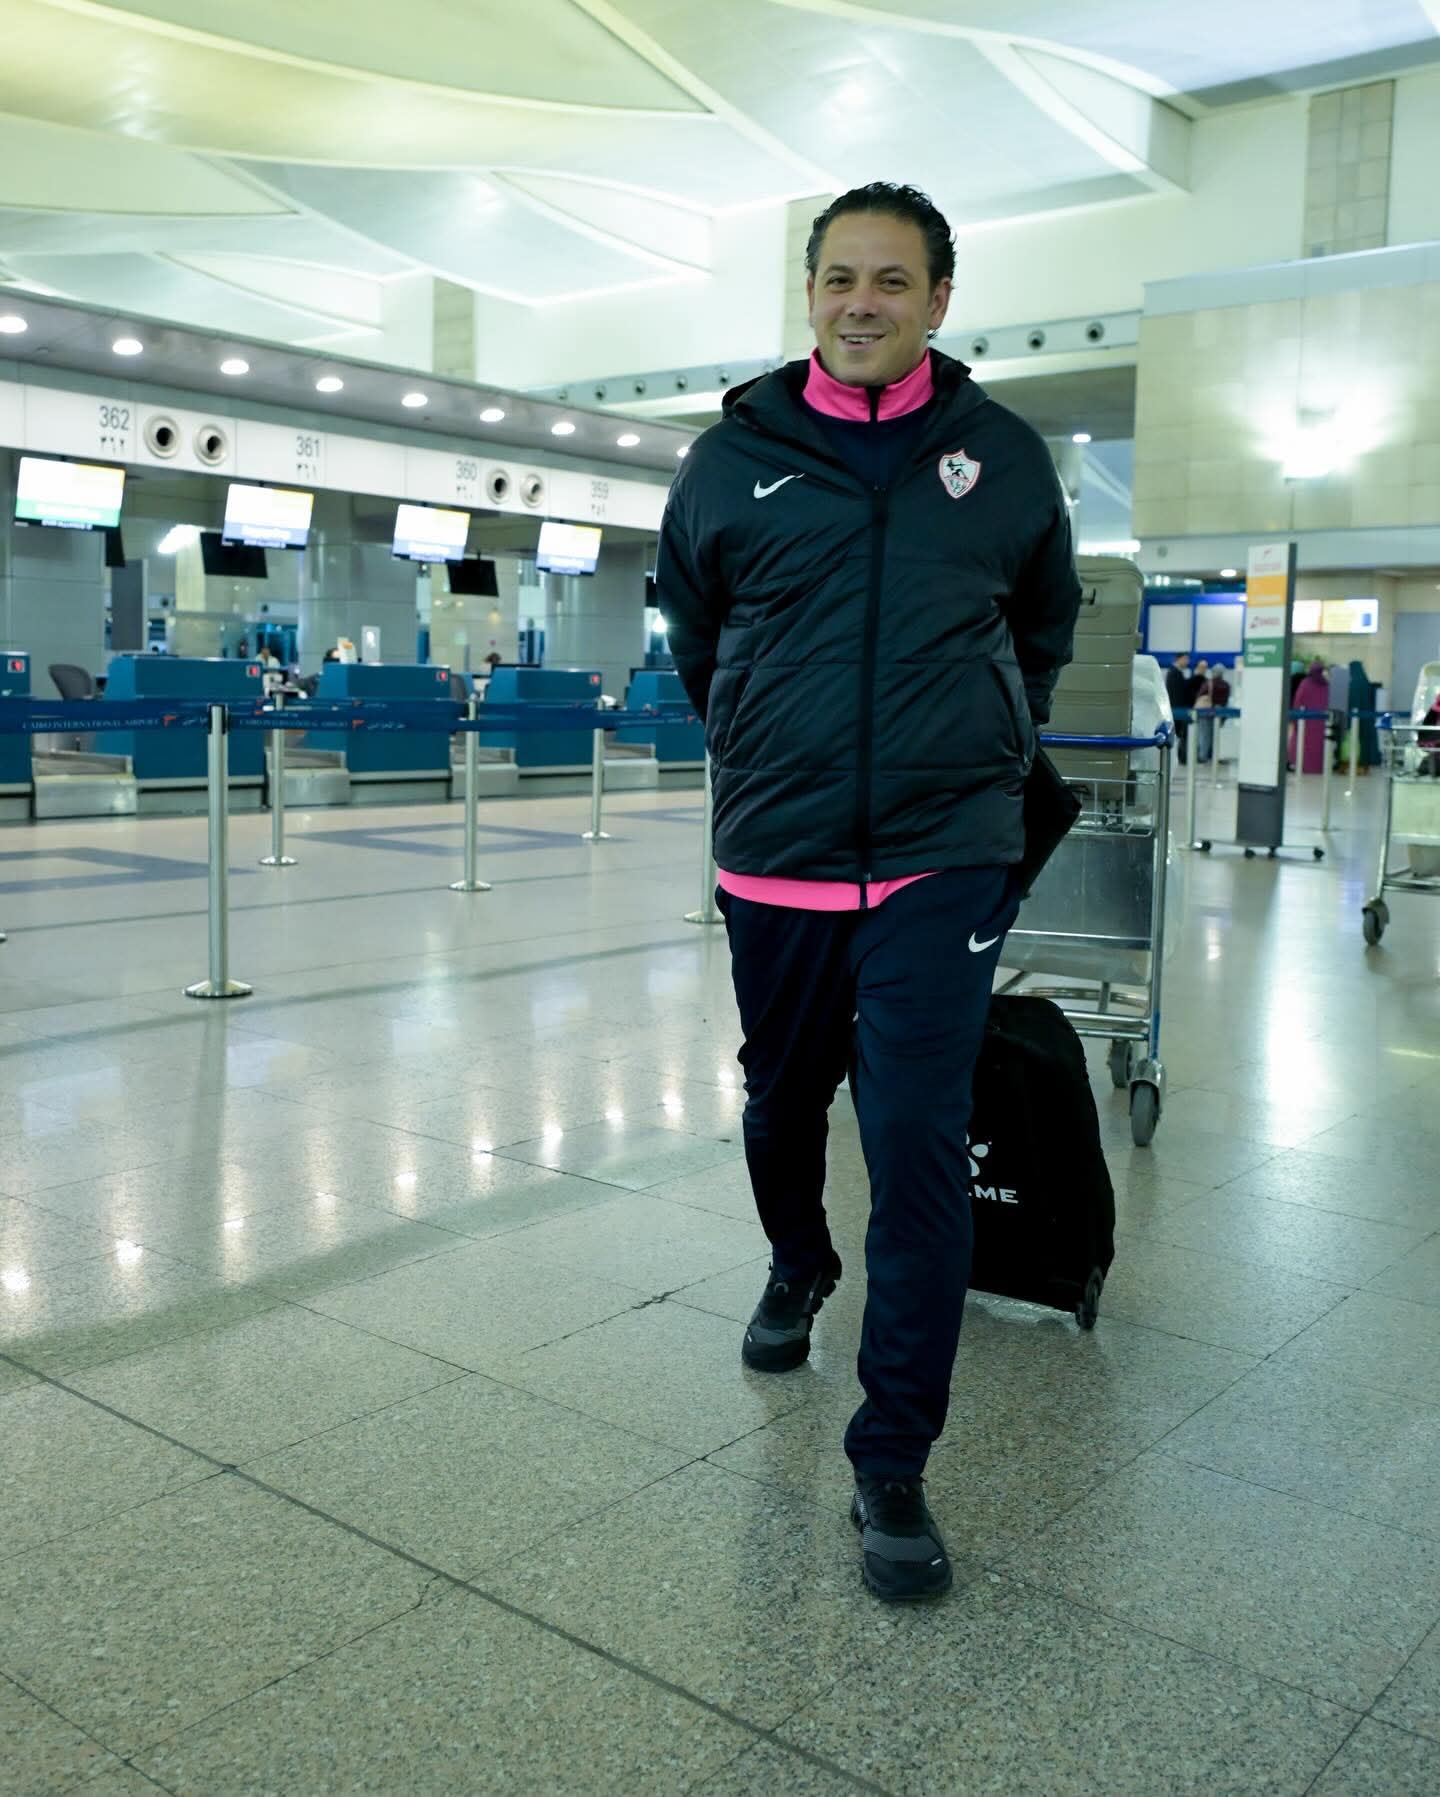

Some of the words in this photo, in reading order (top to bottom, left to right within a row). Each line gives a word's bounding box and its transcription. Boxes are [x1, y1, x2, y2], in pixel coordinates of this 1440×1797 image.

[99, 405, 130, 431] 362
[295, 435, 321, 458] 361
[455, 459, 478, 481] 360
[22, 721, 51, 730] CAIRO
[53, 719, 122, 730] INTERNATIONAL
[124, 718, 159, 728] AIRPORT
